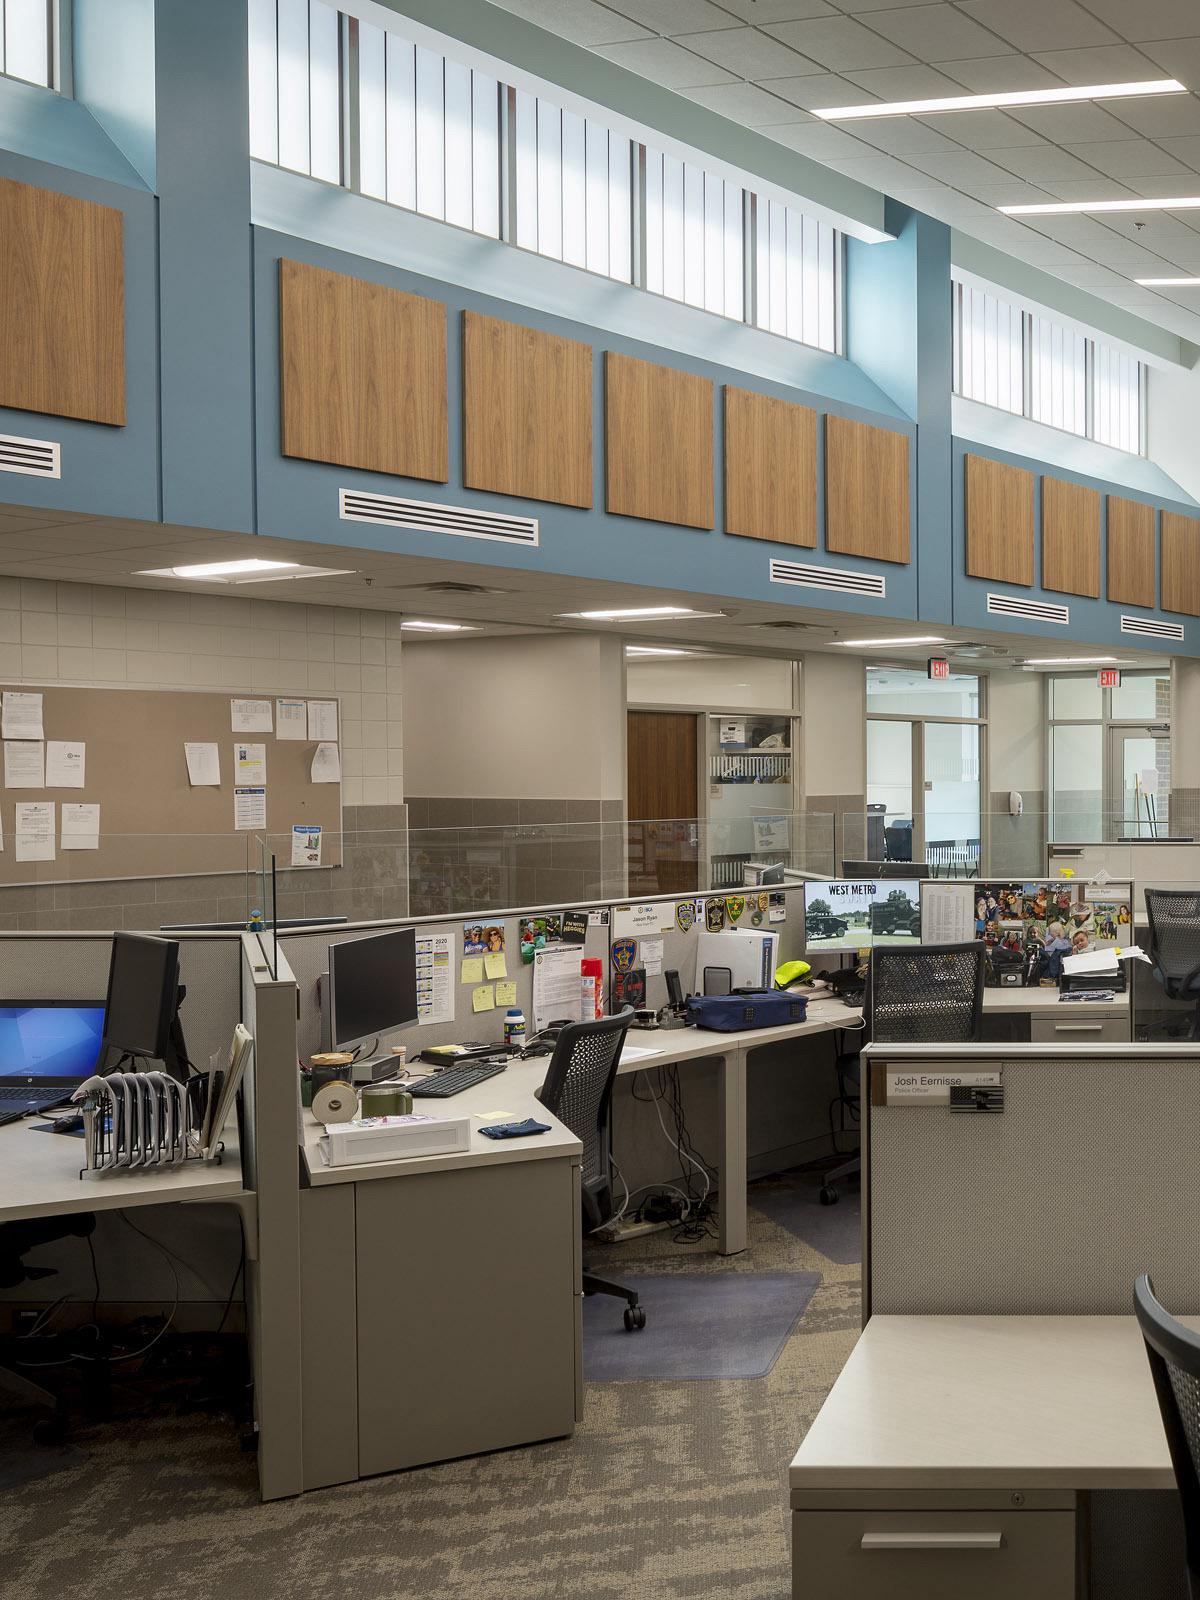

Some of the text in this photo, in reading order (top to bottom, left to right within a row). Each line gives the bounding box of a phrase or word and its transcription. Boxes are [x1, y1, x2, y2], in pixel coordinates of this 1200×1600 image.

[1100, 671, 1117, 686] EXIT
[829, 884, 877, 895] WEST METRO
[679, 903, 694, 911] POLICE
[895, 1076, 962, 1086] Josh Eernisse
